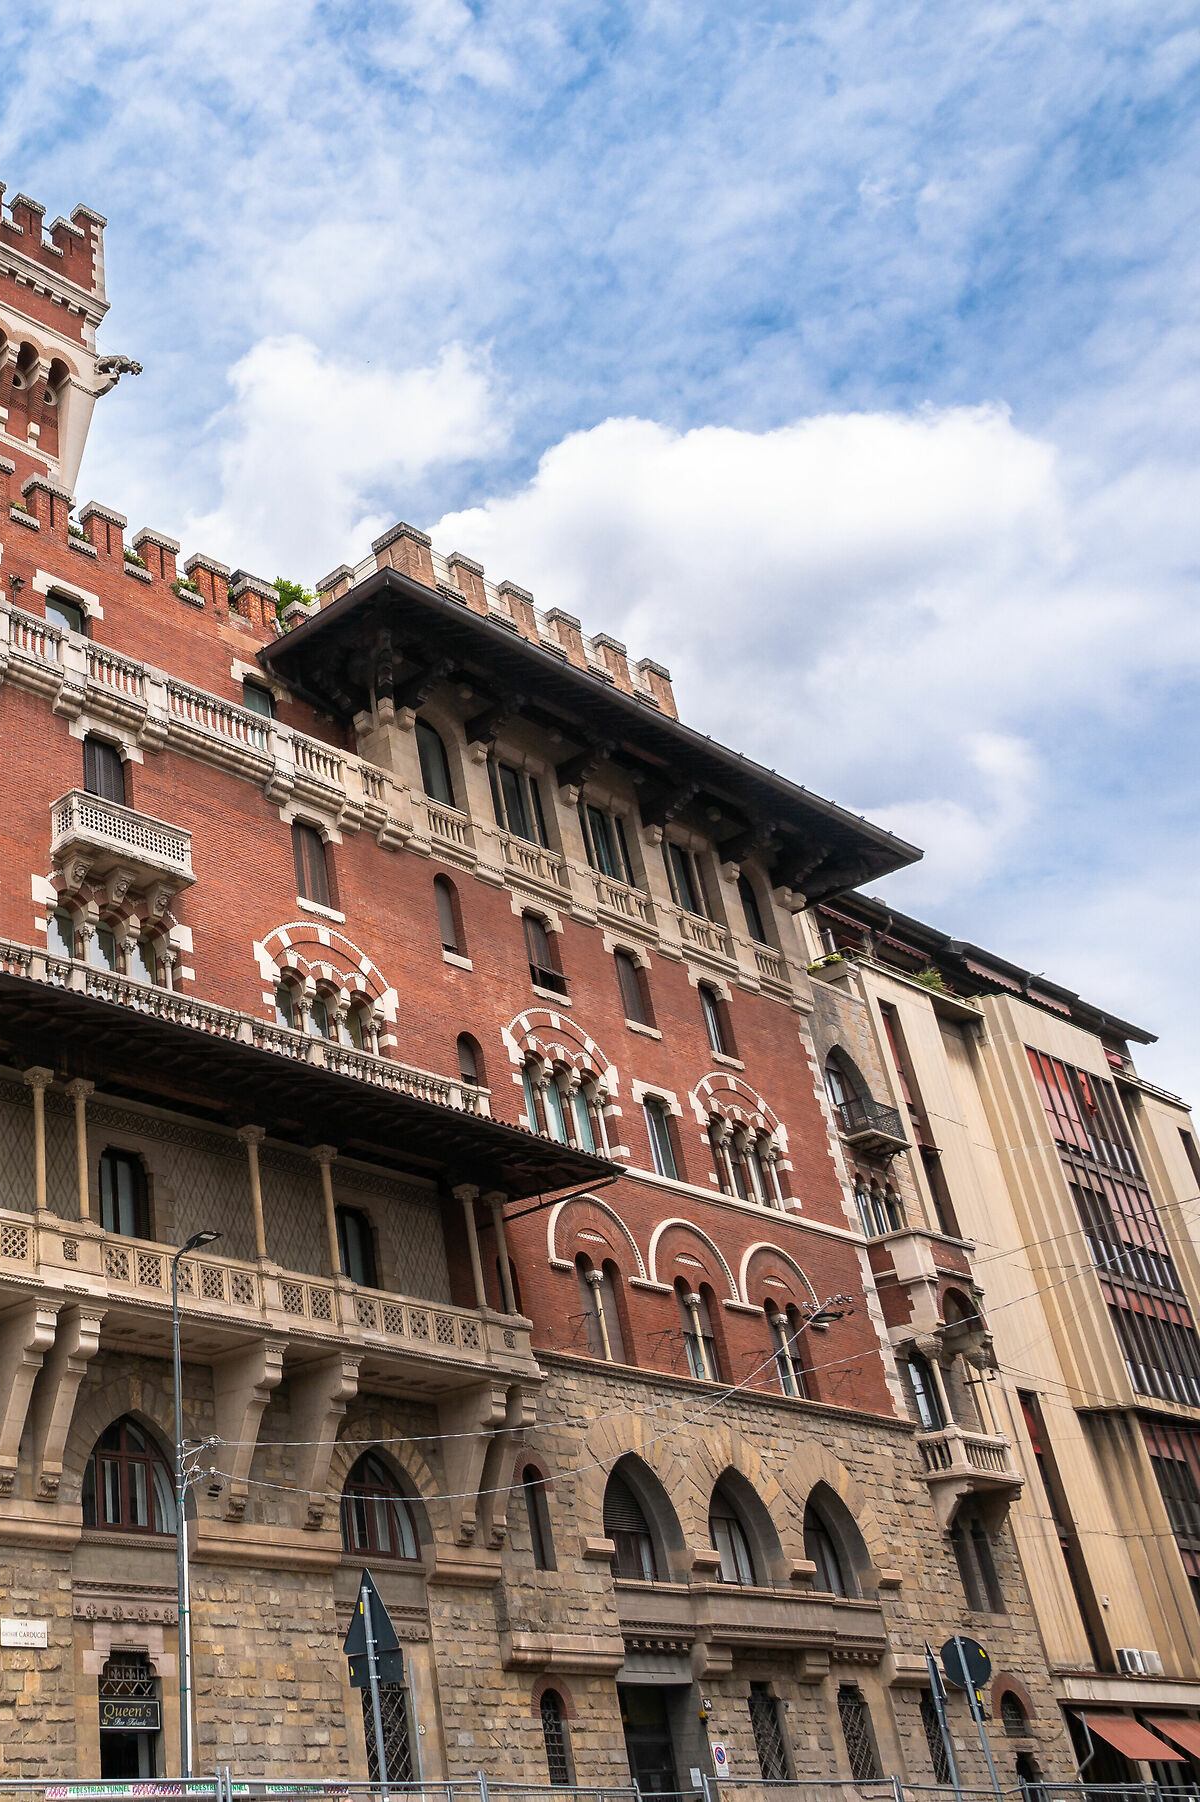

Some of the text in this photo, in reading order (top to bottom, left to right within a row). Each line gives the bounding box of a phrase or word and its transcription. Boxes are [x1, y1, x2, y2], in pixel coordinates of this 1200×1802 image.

[18, 1631, 46, 1639] CARDUCCI
[103, 1703, 152, 1720] Queen's
[69, 1786, 105, 1794] PEDESTRIAN
[106, 1785, 130, 1793] TUNNEL
